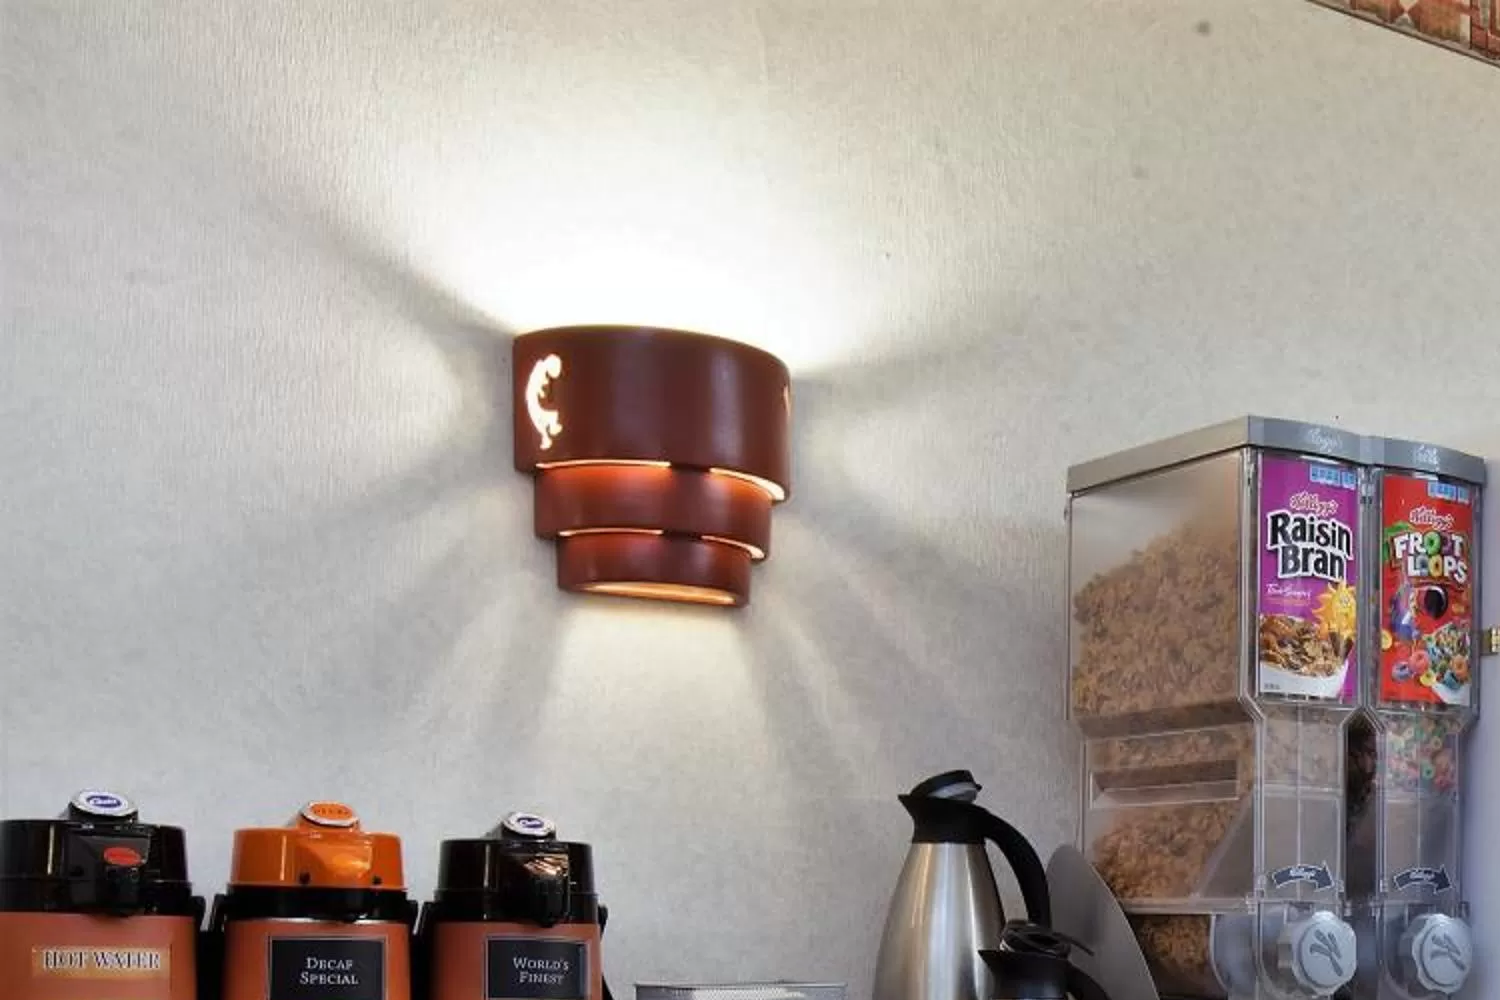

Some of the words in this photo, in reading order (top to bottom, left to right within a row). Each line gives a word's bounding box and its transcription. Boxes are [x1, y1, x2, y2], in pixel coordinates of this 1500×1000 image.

[1267, 511, 1353, 558] Raisin
[1279, 545, 1346, 580] Bran
[1407, 554, 1467, 584] LOOPS
[44, 951, 86, 969] HOT
[92, 951, 161, 969] WATER
[305, 957, 354, 970] DECAF
[513, 957, 569, 971] WORLD'S
[300, 971, 359, 985] SPECIAL
[519, 971, 564, 984] FINEST
